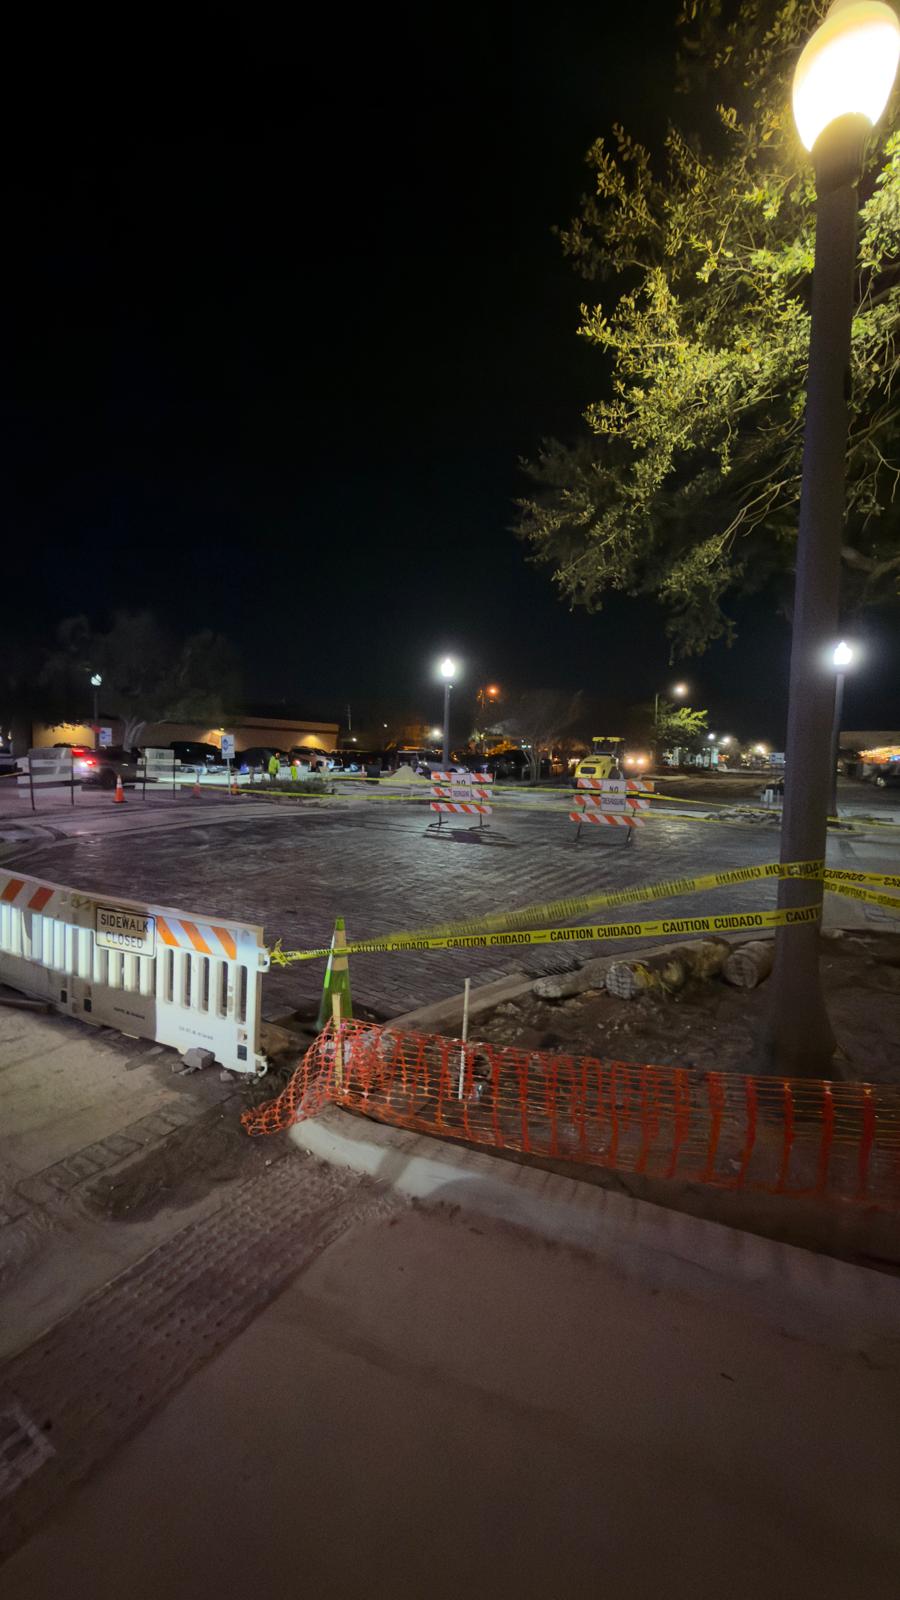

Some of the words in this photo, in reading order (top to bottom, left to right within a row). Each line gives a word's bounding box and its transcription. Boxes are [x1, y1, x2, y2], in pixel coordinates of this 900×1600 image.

[609, 785, 619, 793] NO
[100, 913, 149, 933] SIDEWALK
[446, 936, 487, 948] CAUTION
[490, 934, 531, 945] CUIDADO
[550, 928, 593, 941] CAUTION
[597, 925, 642, 938] CUIDADO
[662, 919, 710, 932] CAUTION
[714, 914, 763, 929] CUIDADO
[785, 908, 819, 923] CAUTI
[106, 930, 144, 949] CLOSED
